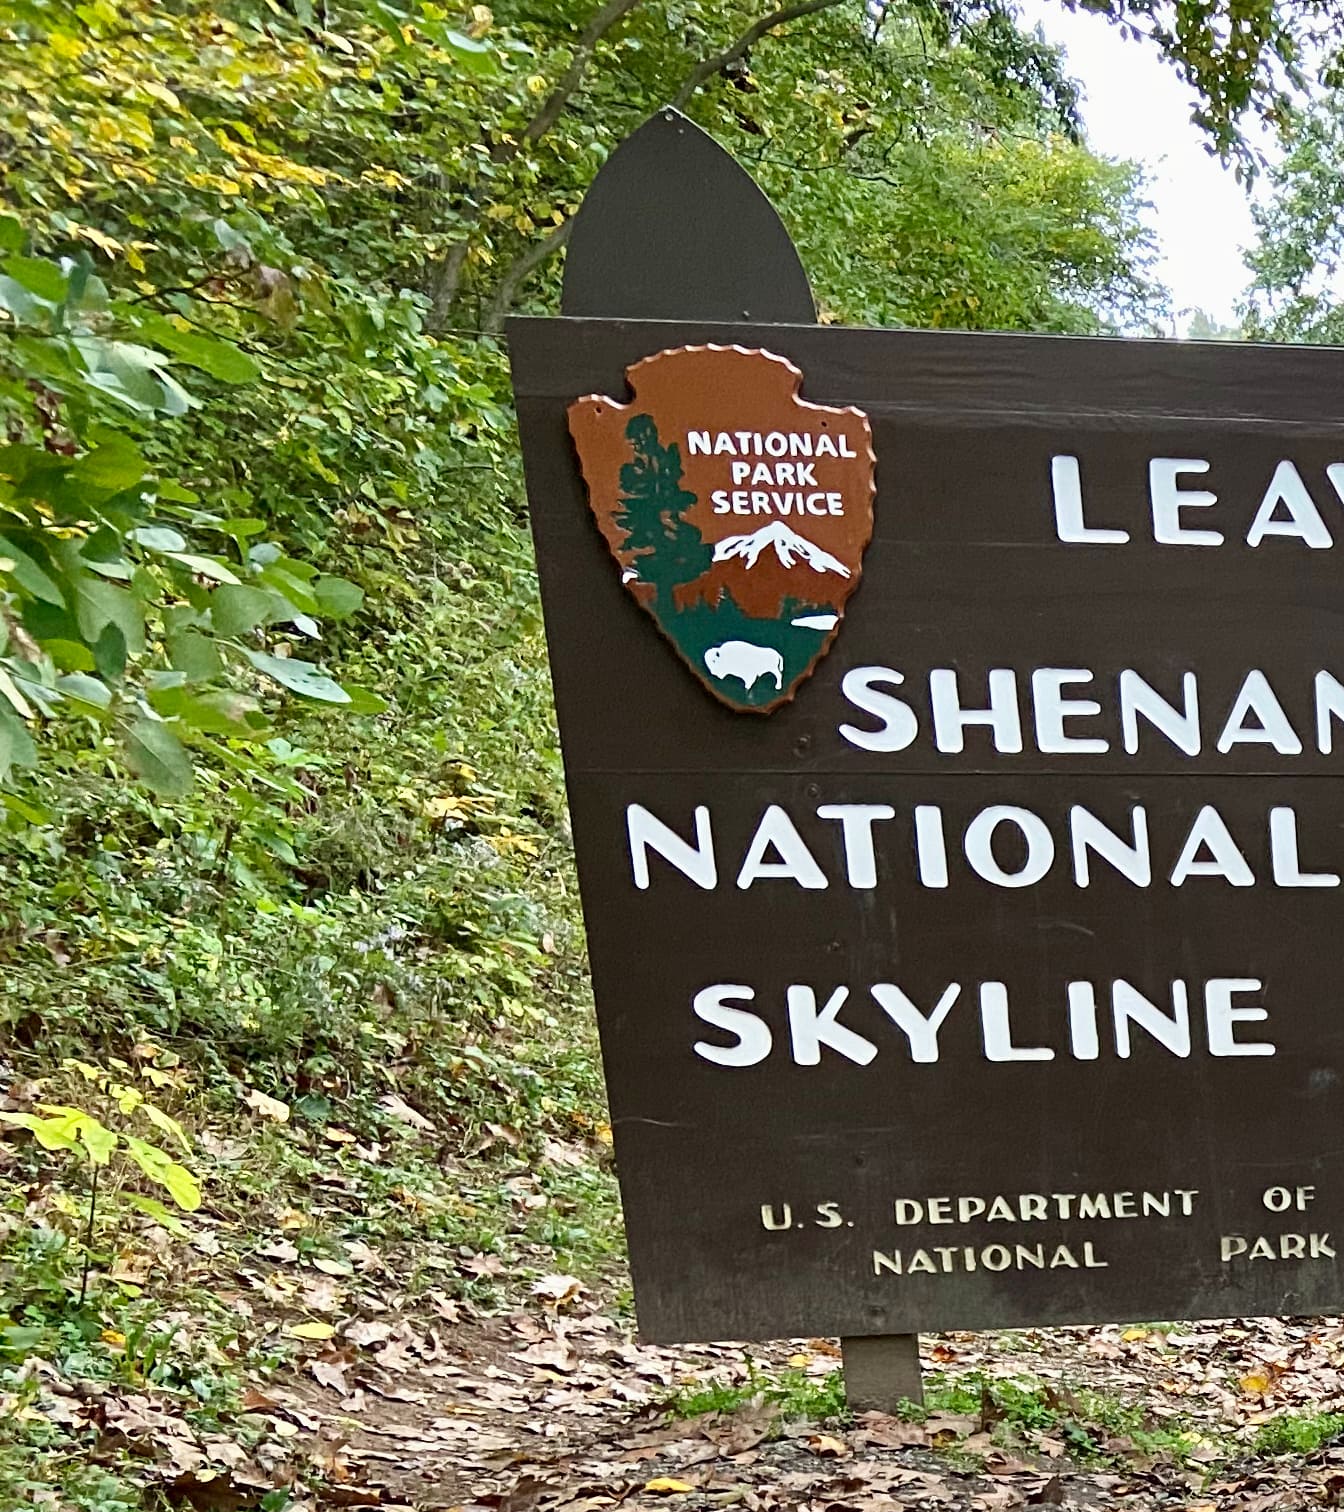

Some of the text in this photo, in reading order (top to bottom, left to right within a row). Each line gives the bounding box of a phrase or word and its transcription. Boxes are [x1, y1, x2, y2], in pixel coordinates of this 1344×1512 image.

[687, 430, 857, 458] NATIONAL
[731, 461, 818, 486] PARK
[711, 490, 845, 516] SERVICE
[626, 803, 1341, 890] NATIONAL
[693, 978, 1276, 1067] SKYLINE
[894, 1189, 1199, 1225] DEPARTMENT
[1262, 1185, 1315, 1212] OF
[873, 1241, 1109, 1276] NATIONAL
[1221, 1233, 1337, 1263] PARK
